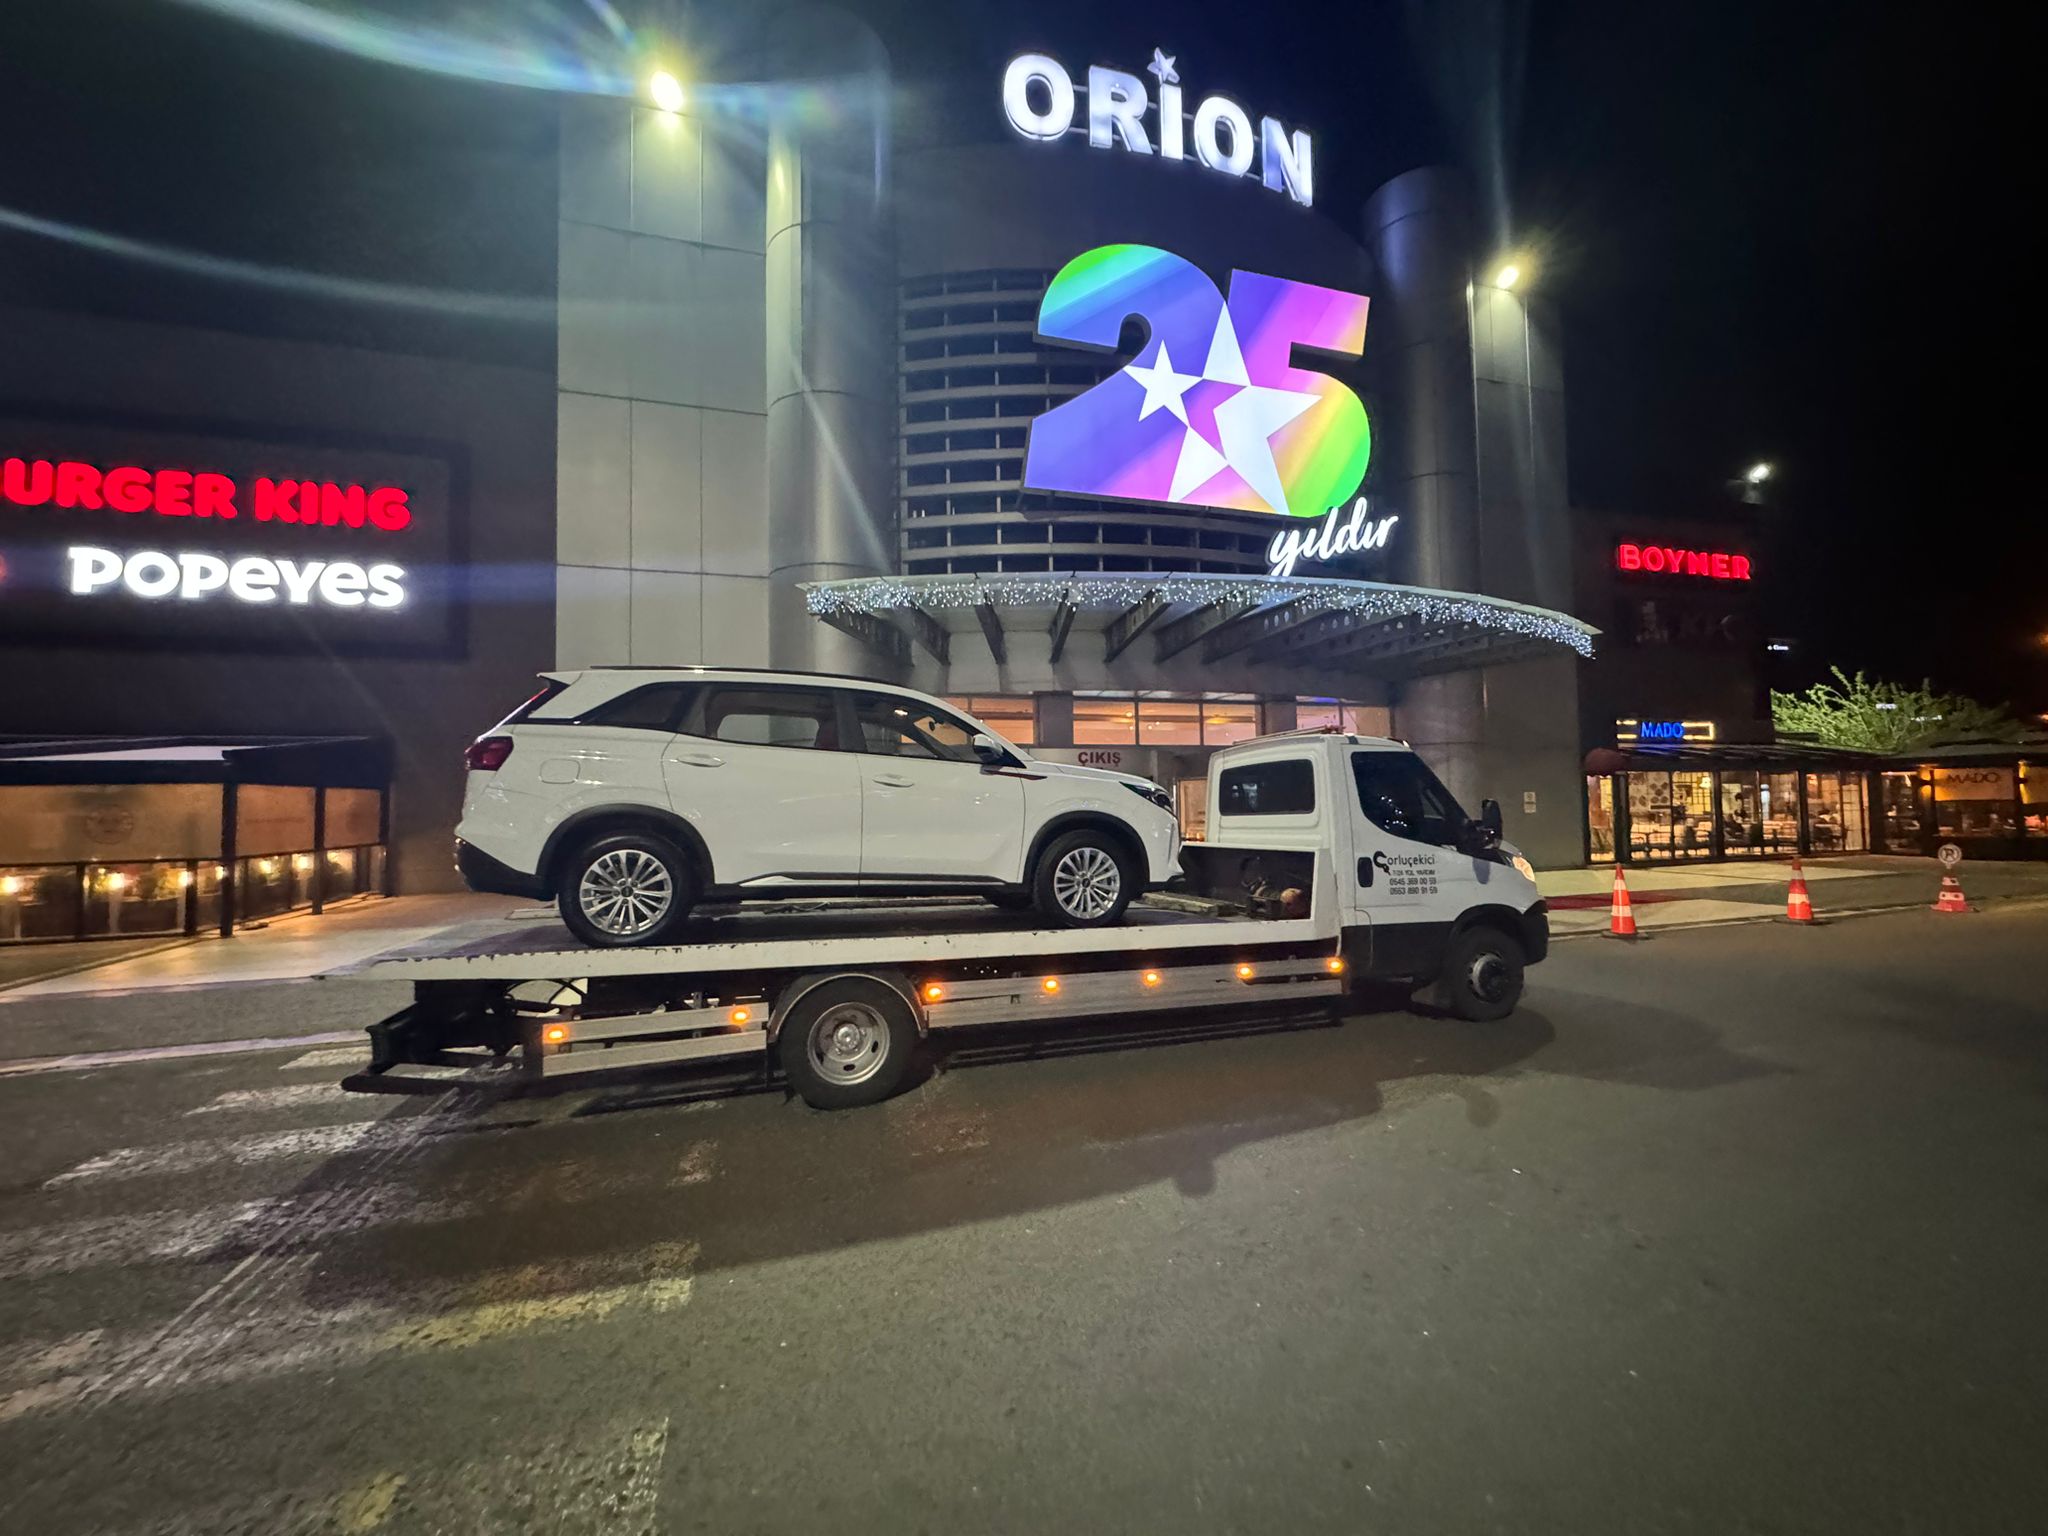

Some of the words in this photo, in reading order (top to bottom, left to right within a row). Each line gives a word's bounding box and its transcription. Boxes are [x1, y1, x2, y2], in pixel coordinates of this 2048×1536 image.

[1023, 243, 1371, 518] 25
[0, 457, 238, 519] URGER
[254, 477, 412, 531] KING
[1618, 544, 1751, 580] BOYNER
[1641, 721, 1684, 739] MADO
[1078, 751, 1121, 767] ÇIKIŞ
[1948, 772, 2001, 785] MADO
